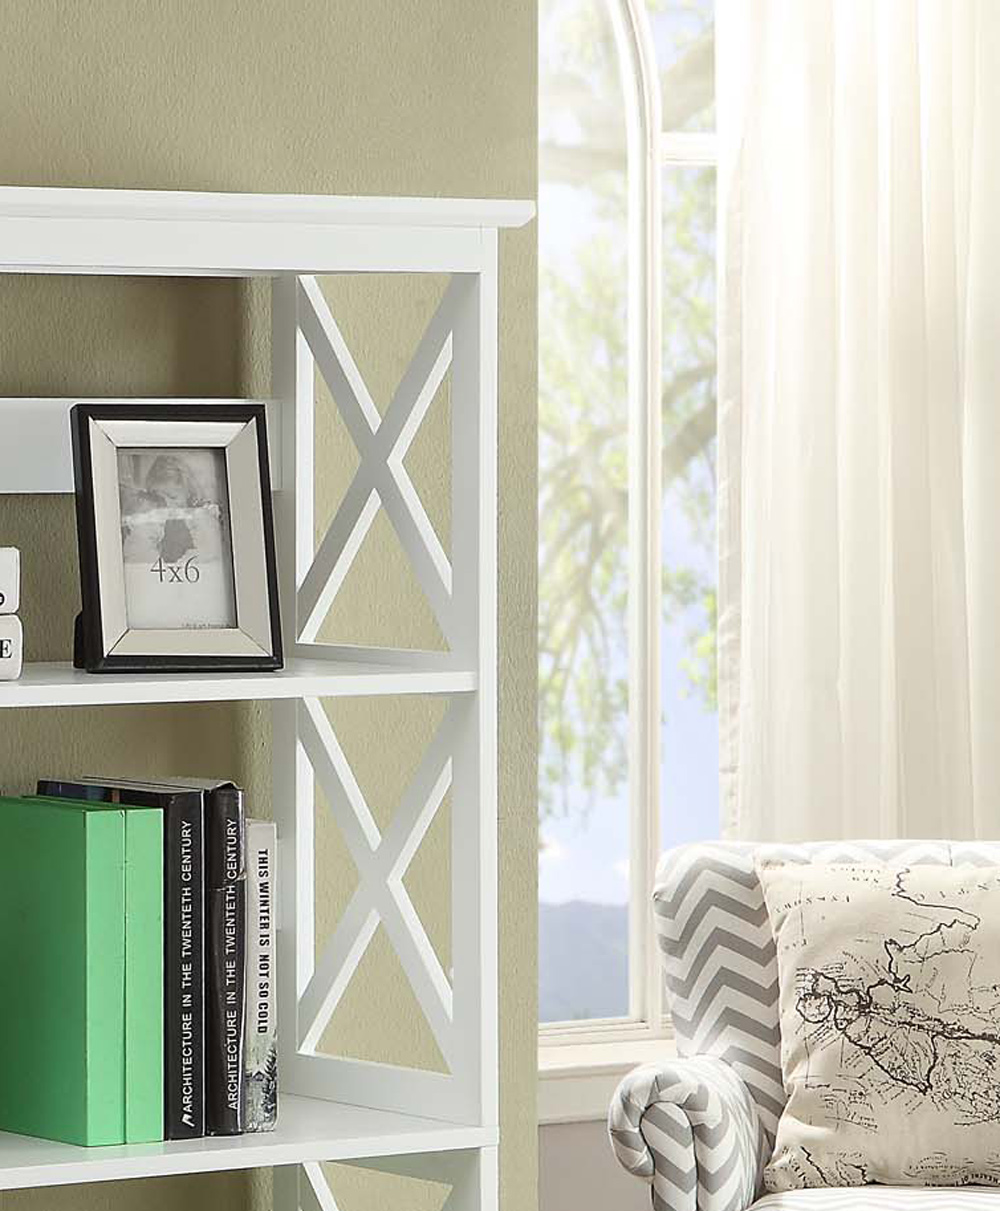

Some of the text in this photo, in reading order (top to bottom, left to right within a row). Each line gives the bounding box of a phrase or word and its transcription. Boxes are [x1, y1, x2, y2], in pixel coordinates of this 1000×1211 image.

[150, 556, 200, 584] 4x6
[182, 820, 193, 1115] ARCHITECTURE IN THE TWENTETH CENTURY
[226, 819, 239, 1110] ARCHITECTURE IN THE TWENTETH CENTURY
[258, 849, 270, 1034] THIS WINTER IS NOT SO COLD
